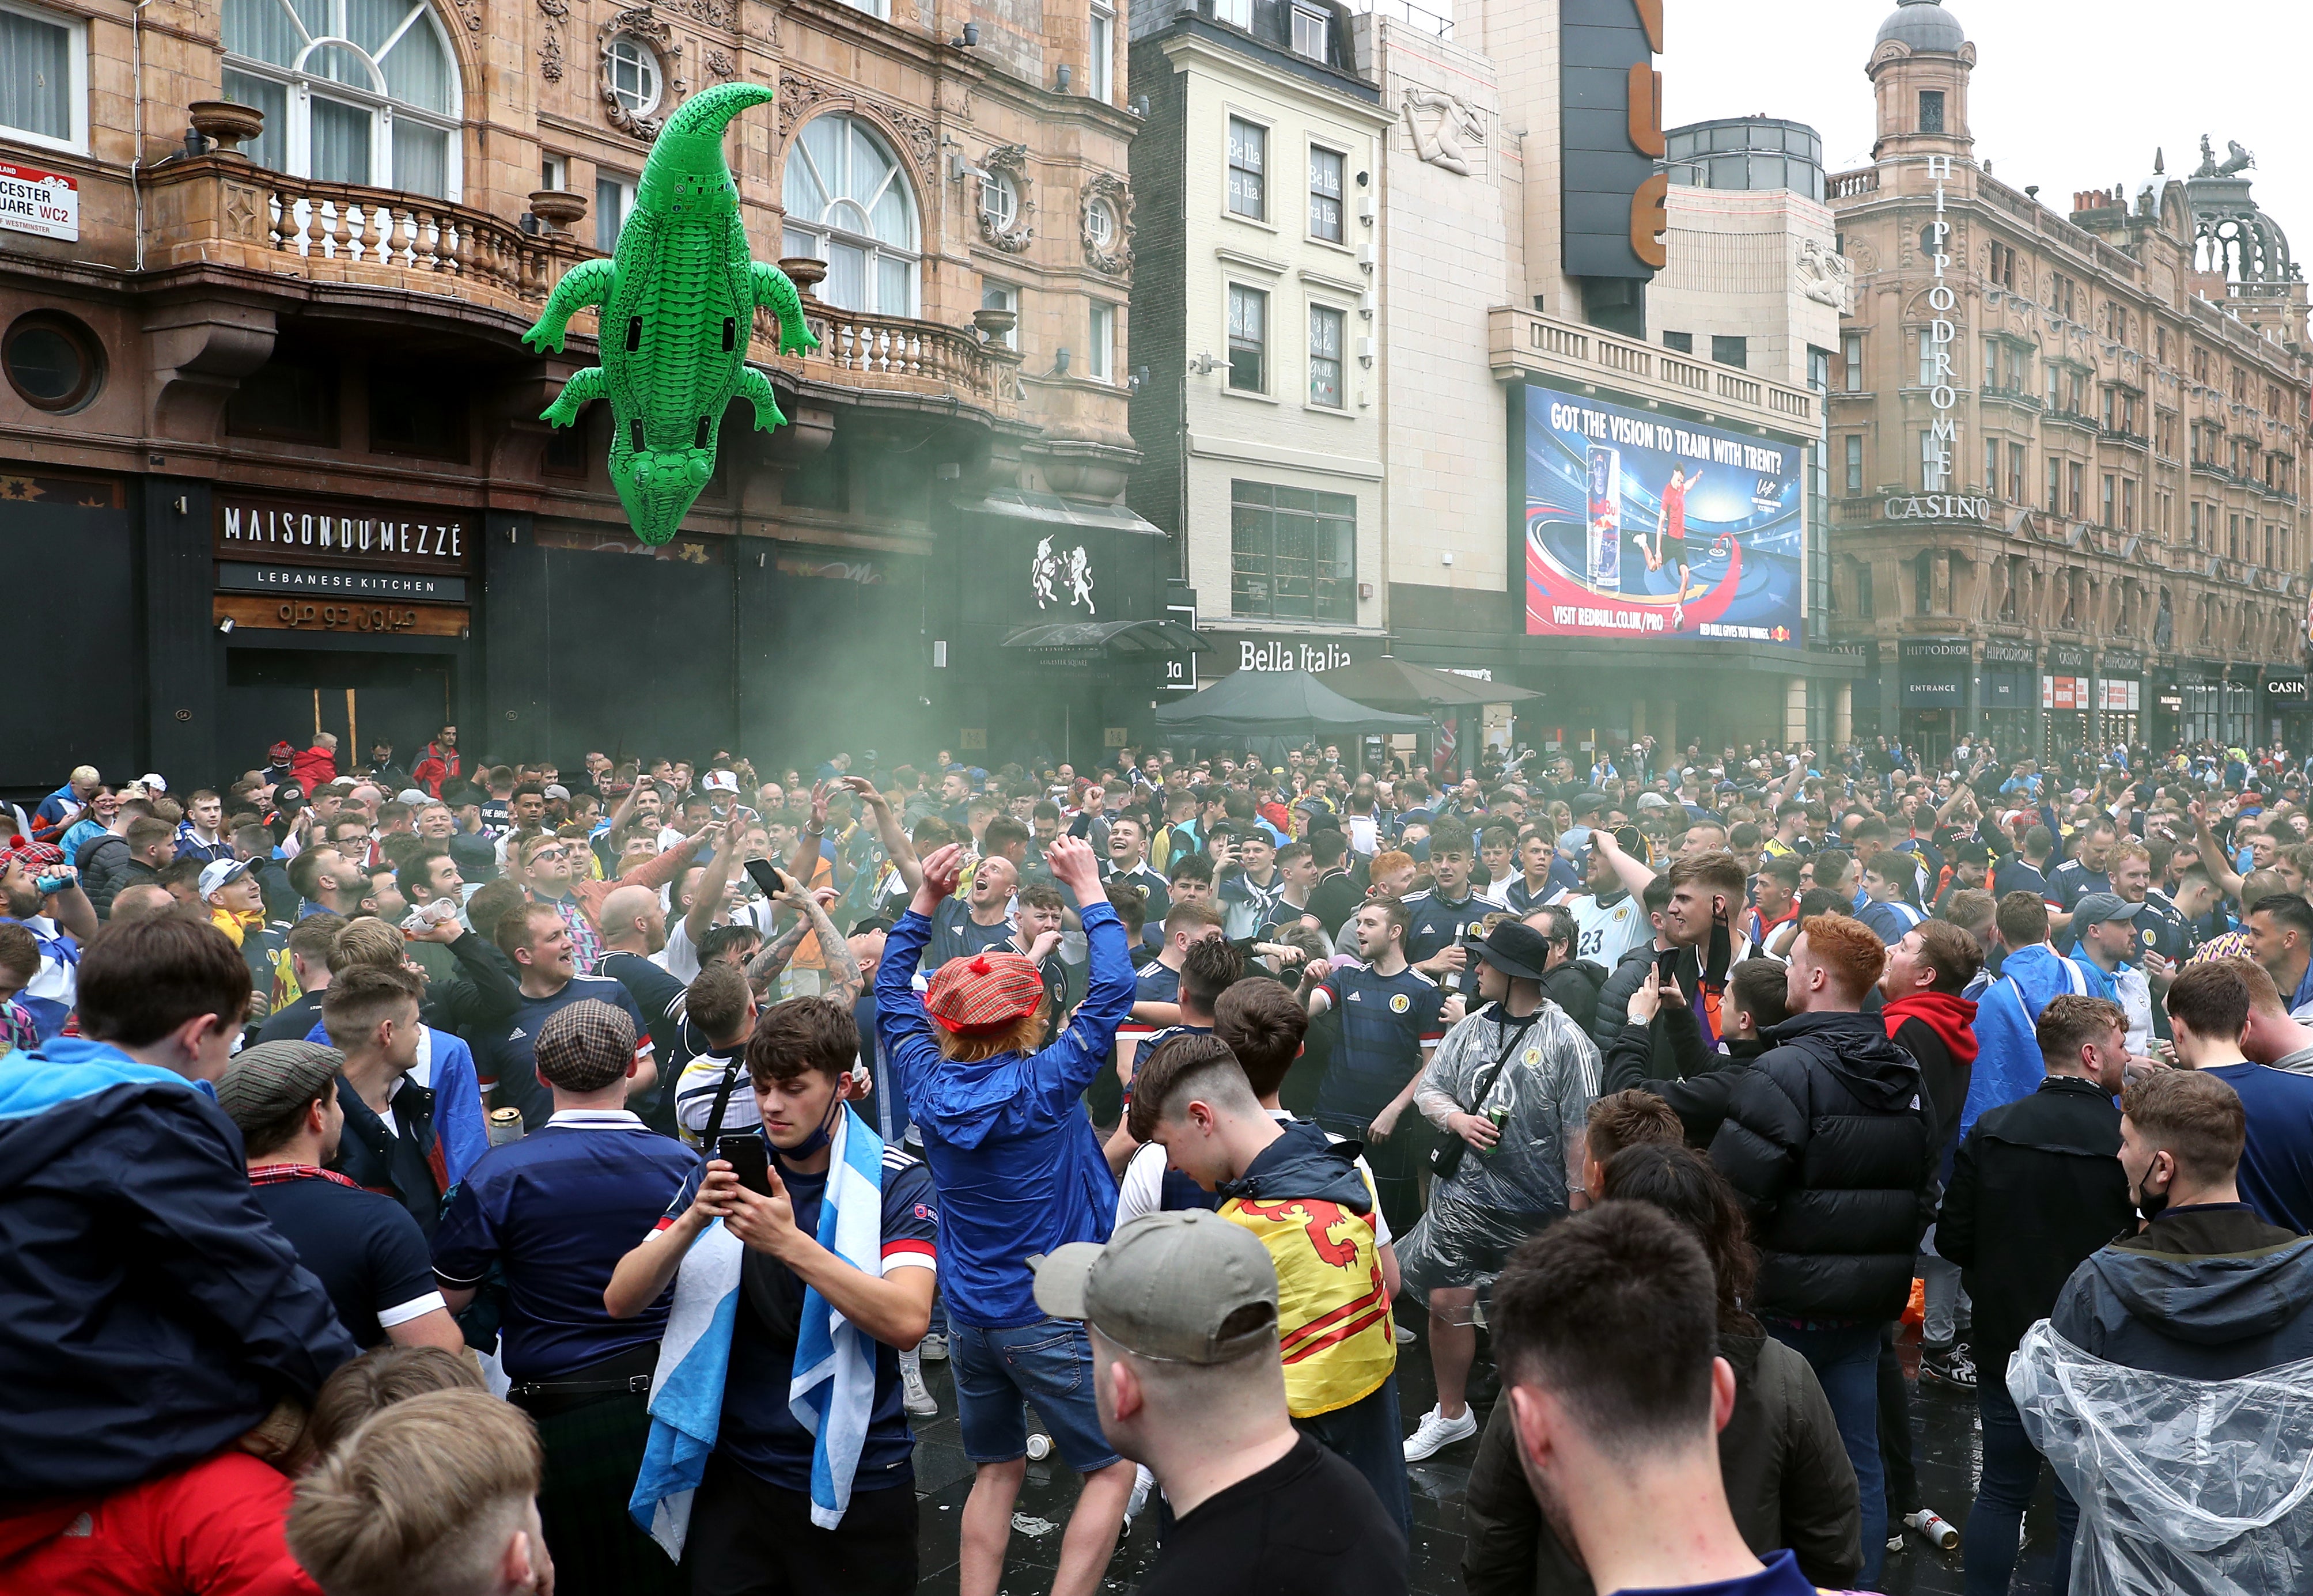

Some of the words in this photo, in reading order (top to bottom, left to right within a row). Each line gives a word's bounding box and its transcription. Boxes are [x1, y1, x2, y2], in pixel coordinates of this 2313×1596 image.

[1229, 137, 1260, 165] Bella
[1310, 164, 1339, 191] Bella
[1229, 179, 1259, 200] talia
[39, 205, 69, 222] WC2
[1310, 204, 1337, 225] talia
[6, 219, 51, 233] WESTMINSTER
[1927, 156, 1957, 475] HIPPODROME
[1551, 402, 1580, 433] GOT
[1582, 409, 1607, 439] THE
[1609, 415, 1654, 449] VISION
[1656, 425, 1673, 453] TO
[1675, 430, 1710, 461] TRAIN
[1712, 438, 1742, 467] WITH
[1744, 445, 1782, 475] TRENT?
[1884, 494, 1990, 521] CASINO
[225, 507, 330, 547] MAISON
[342, 518, 369, 550] DU
[381, 521, 461, 556] MEZZÉ
[258, 572, 352, 587] LEBANESE
[361, 578, 434, 592] KITCHEN
[1552, 605, 1577, 625] VISIT
[1578, 608, 1663, 634] REDBULL.CO.UK/PRO
[1699, 623, 1710, 635] RED
[1723, 625, 1737, 638] GIVES
[1737, 625, 1748, 638] YOU
[1239, 640, 1294, 672] Bella
[1300, 643, 1351, 673] Italia
[1906, 645, 1970, 655] HIPPODROME
[1987, 646, 2034, 662] HIPPODROME
[2059, 651, 2081, 665] CASINO
[2104, 656, 2141, 670] HIPPODROME
[1957, 750, 1968, 760] 10
[482, 809, 494, 817] THE
[1580, 929, 1603, 957] 23
